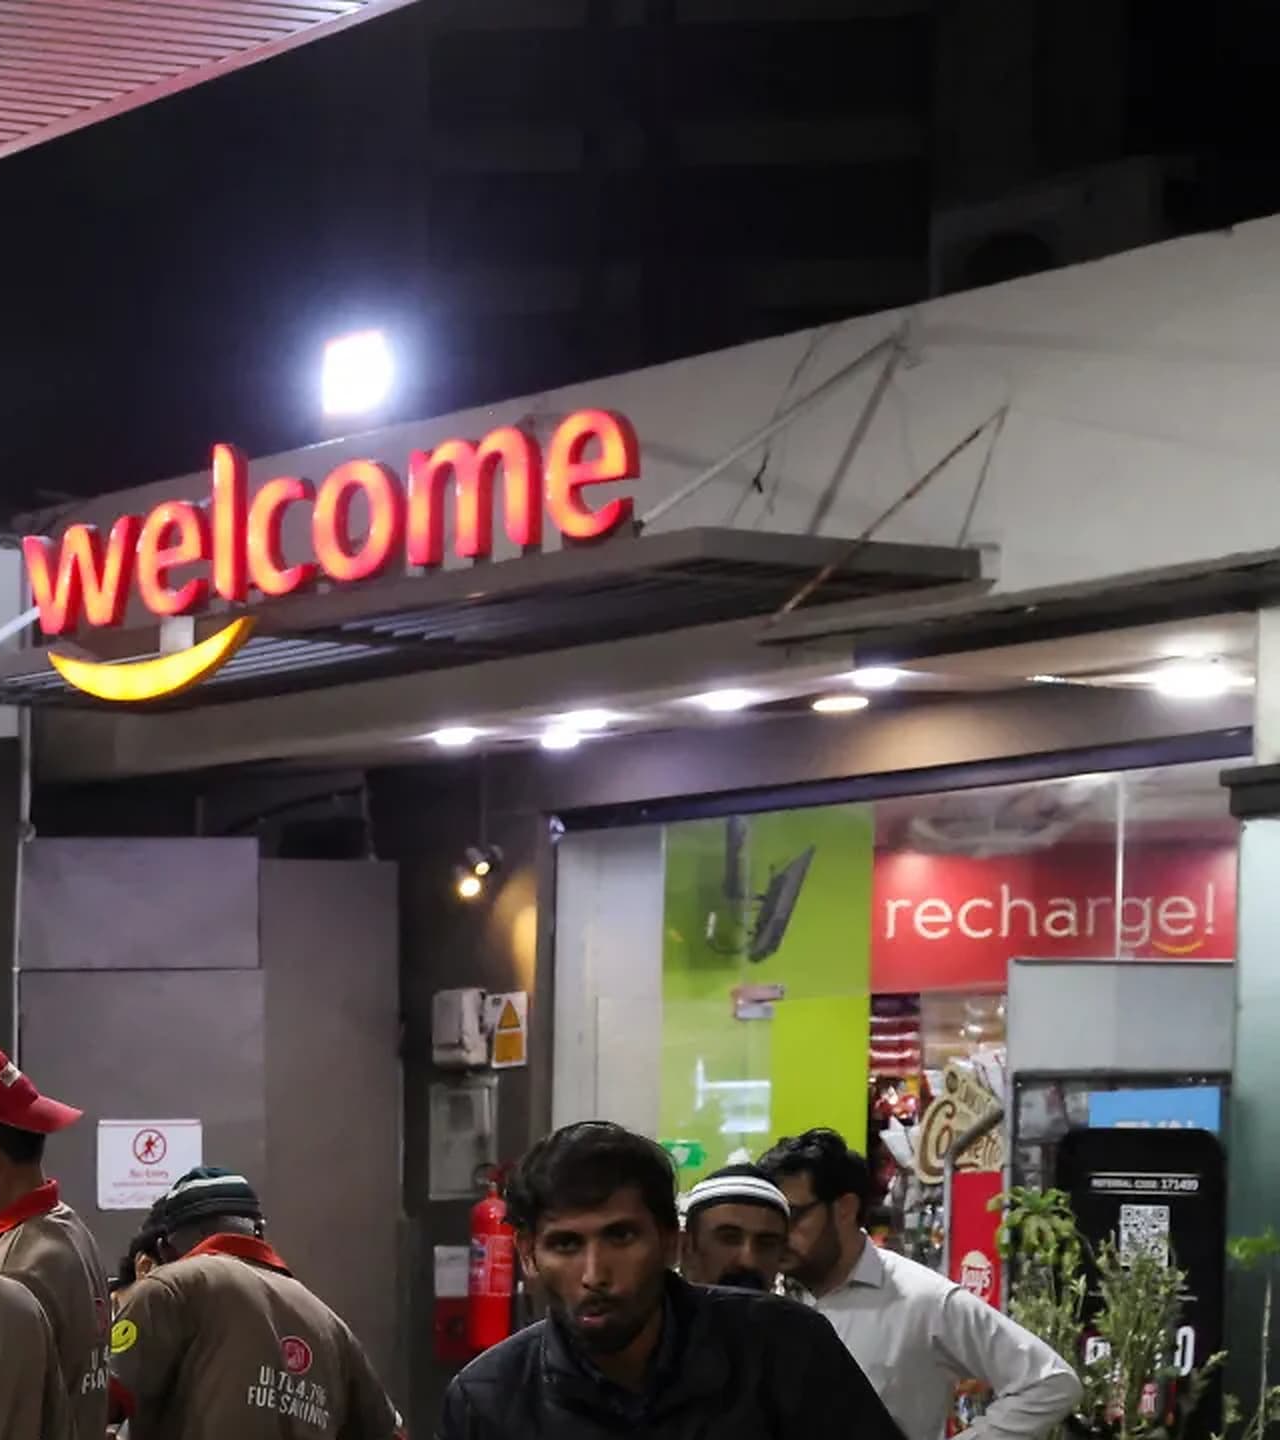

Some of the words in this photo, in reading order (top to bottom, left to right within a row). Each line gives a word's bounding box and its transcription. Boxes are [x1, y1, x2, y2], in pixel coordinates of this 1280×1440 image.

[23, 408, 642, 636] welcome
[885, 882, 1217, 947] recharge!
[248, 1386, 276, 1409] FUE
